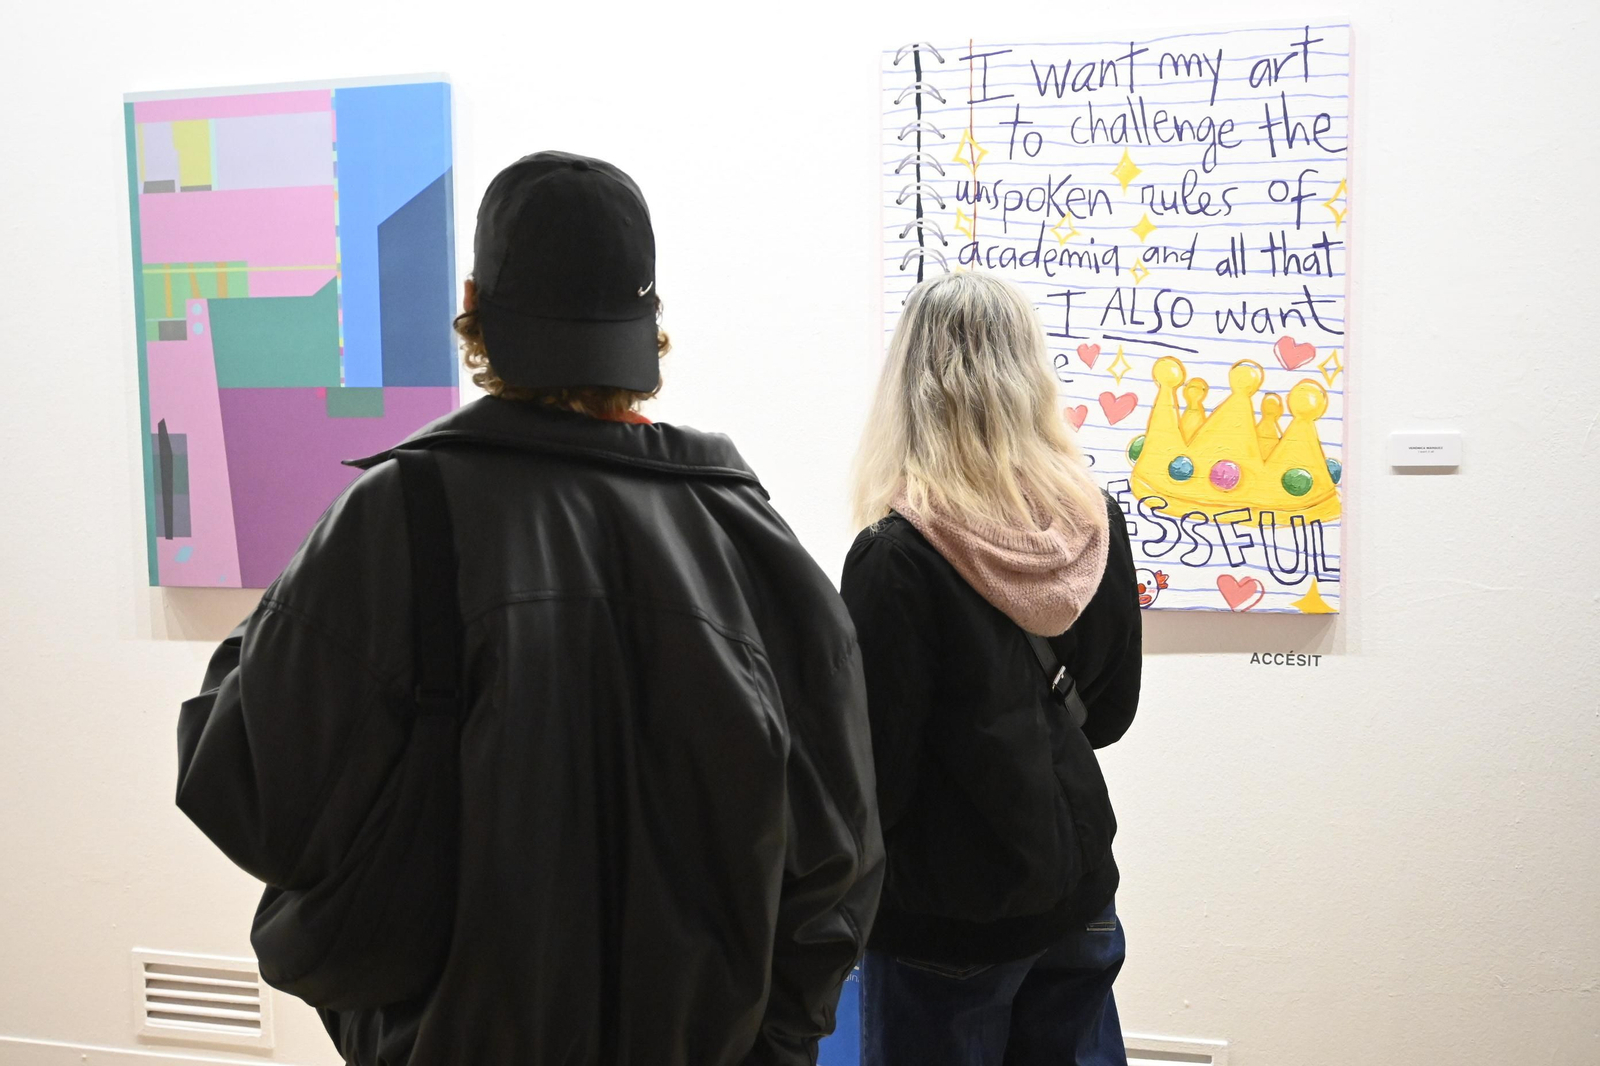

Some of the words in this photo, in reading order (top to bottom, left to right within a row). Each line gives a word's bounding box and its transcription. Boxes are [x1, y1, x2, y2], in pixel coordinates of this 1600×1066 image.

[958, 49, 1015, 104] I
[1031, 42, 1149, 98] want
[1159, 48, 1222, 106] my
[1249, 25, 1324, 88] art
[1000, 103, 1043, 159] to
[1070, 96, 1242, 173] challenge
[1259, 91, 1348, 157] the
[955, 174, 1112, 233] unspoken
[1141, 169, 1239, 216] rules
[1267, 168, 1319, 230] of
[958, 221, 1119, 277] academia
[1142, 232, 1198, 270] and
[1215, 232, 1246, 278] all
[1260, 229, 1344, 278] that
[1046, 289, 1090, 339] I
[1100, 287, 1194, 332] ALSO
[1215, 285, 1345, 335] want
[1106, 478, 1340, 585] ESSFUL
[1249, 650, 1322, 667] ACCÉSIT
